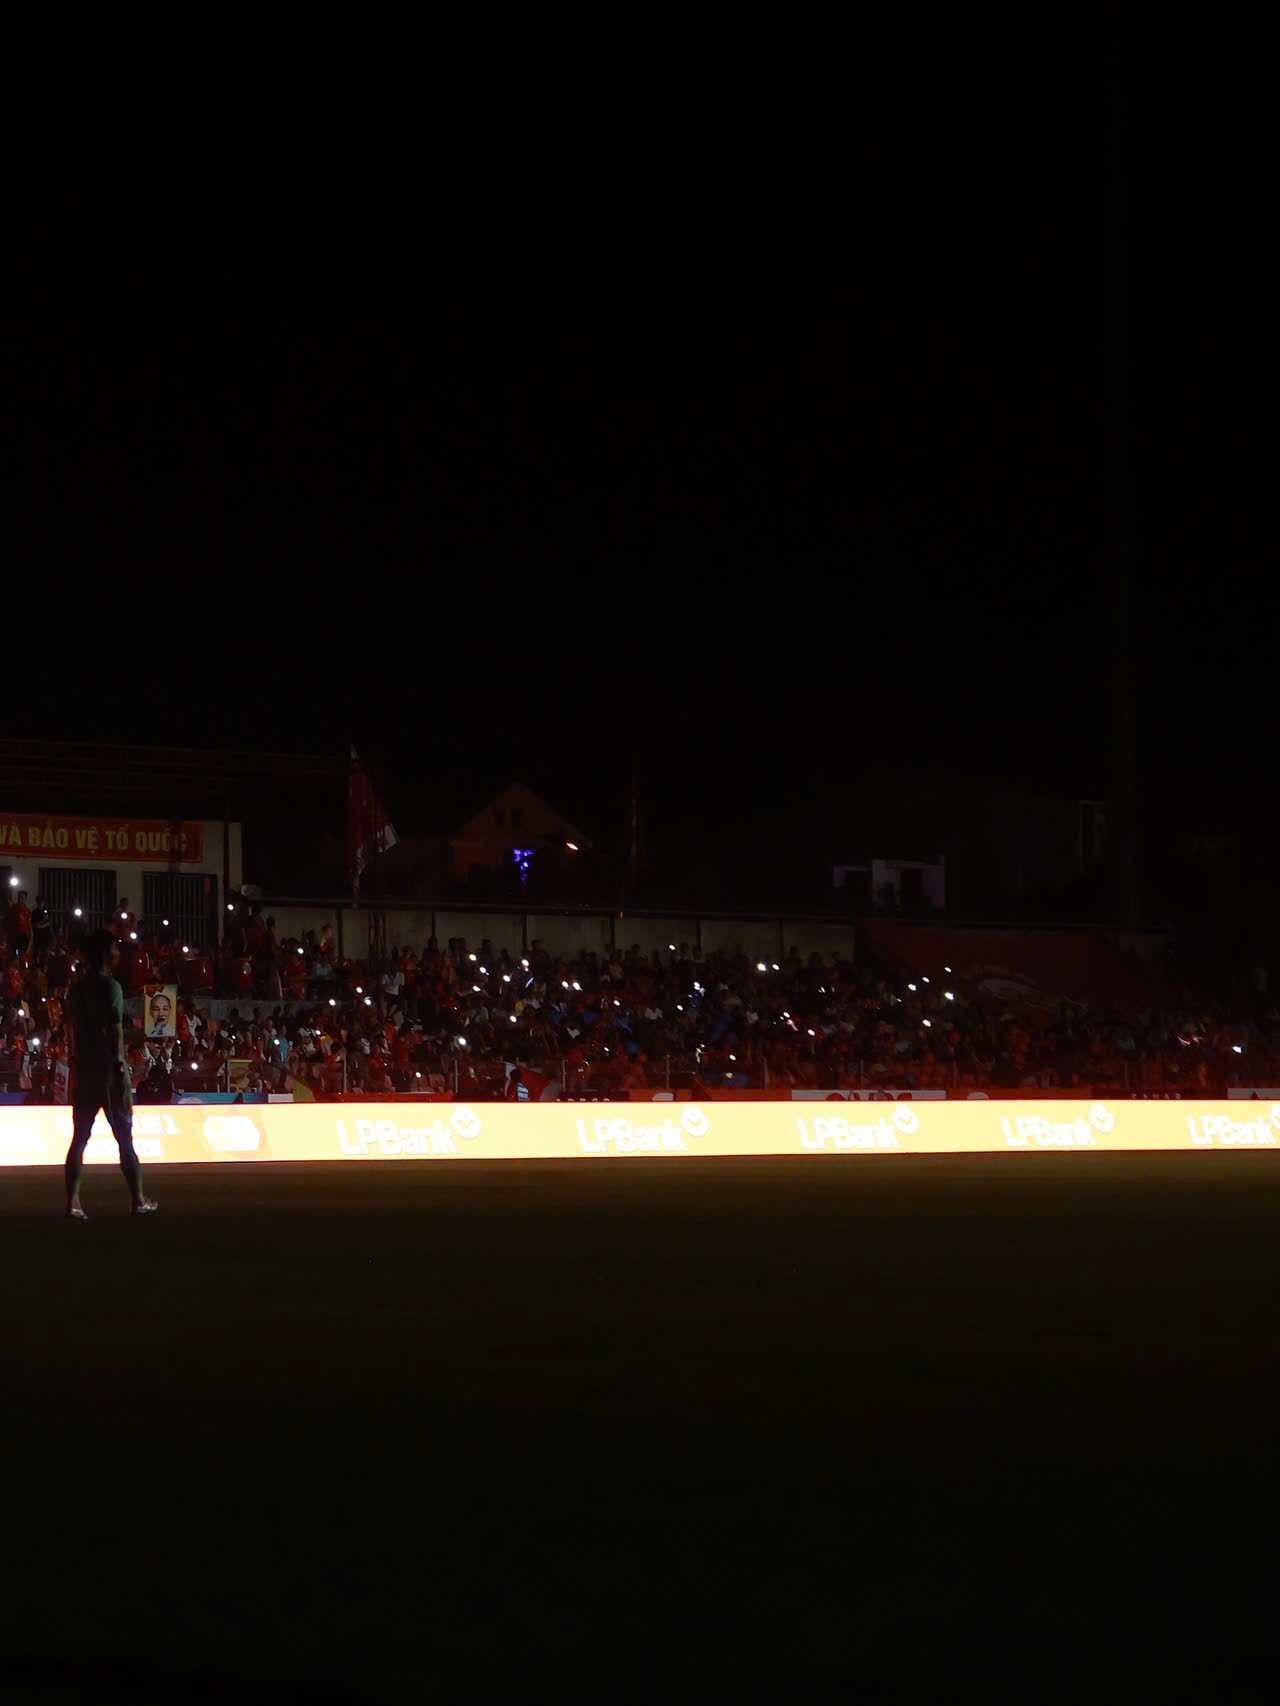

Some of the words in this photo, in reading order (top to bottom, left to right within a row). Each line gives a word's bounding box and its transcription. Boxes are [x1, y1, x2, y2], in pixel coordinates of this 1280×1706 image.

[28, 821, 69, 849] BẢO
[75, 825, 99, 854] VỆ
[105, 823, 129, 850] TỔ
[336, 1119, 458, 1155] LPBank
[576, 1118, 687, 1153] LPBank
[797, 1116, 901, 1148] LPBank
[1000, 1114, 1095, 1146] LPBank
[1187, 1114, 1276, 1145] LPBank
